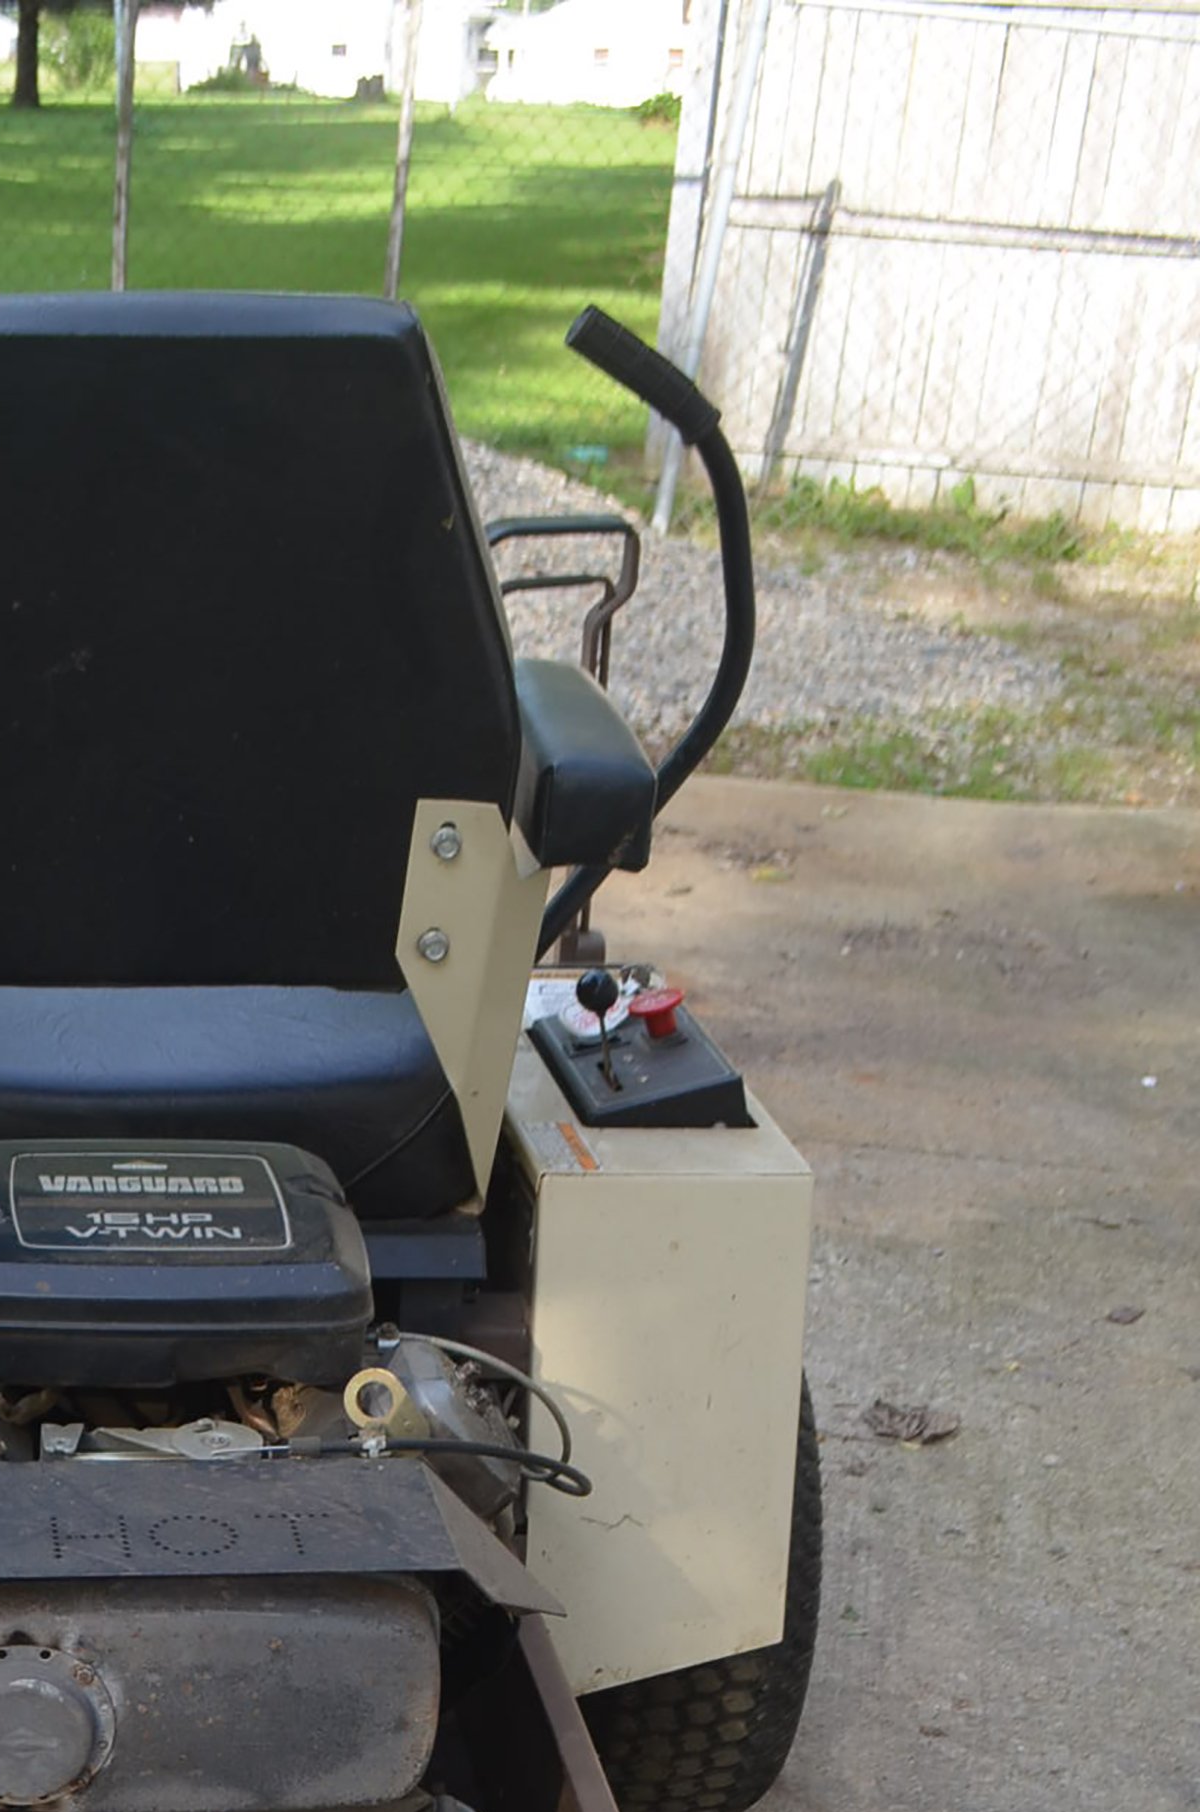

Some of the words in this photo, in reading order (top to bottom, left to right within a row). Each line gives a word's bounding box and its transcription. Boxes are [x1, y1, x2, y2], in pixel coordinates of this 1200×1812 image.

[37, 1174, 245, 1195] VANGUARD
[64, 1225, 243, 1239] V-TWIN
[49, 1512, 330, 1559] HOT
